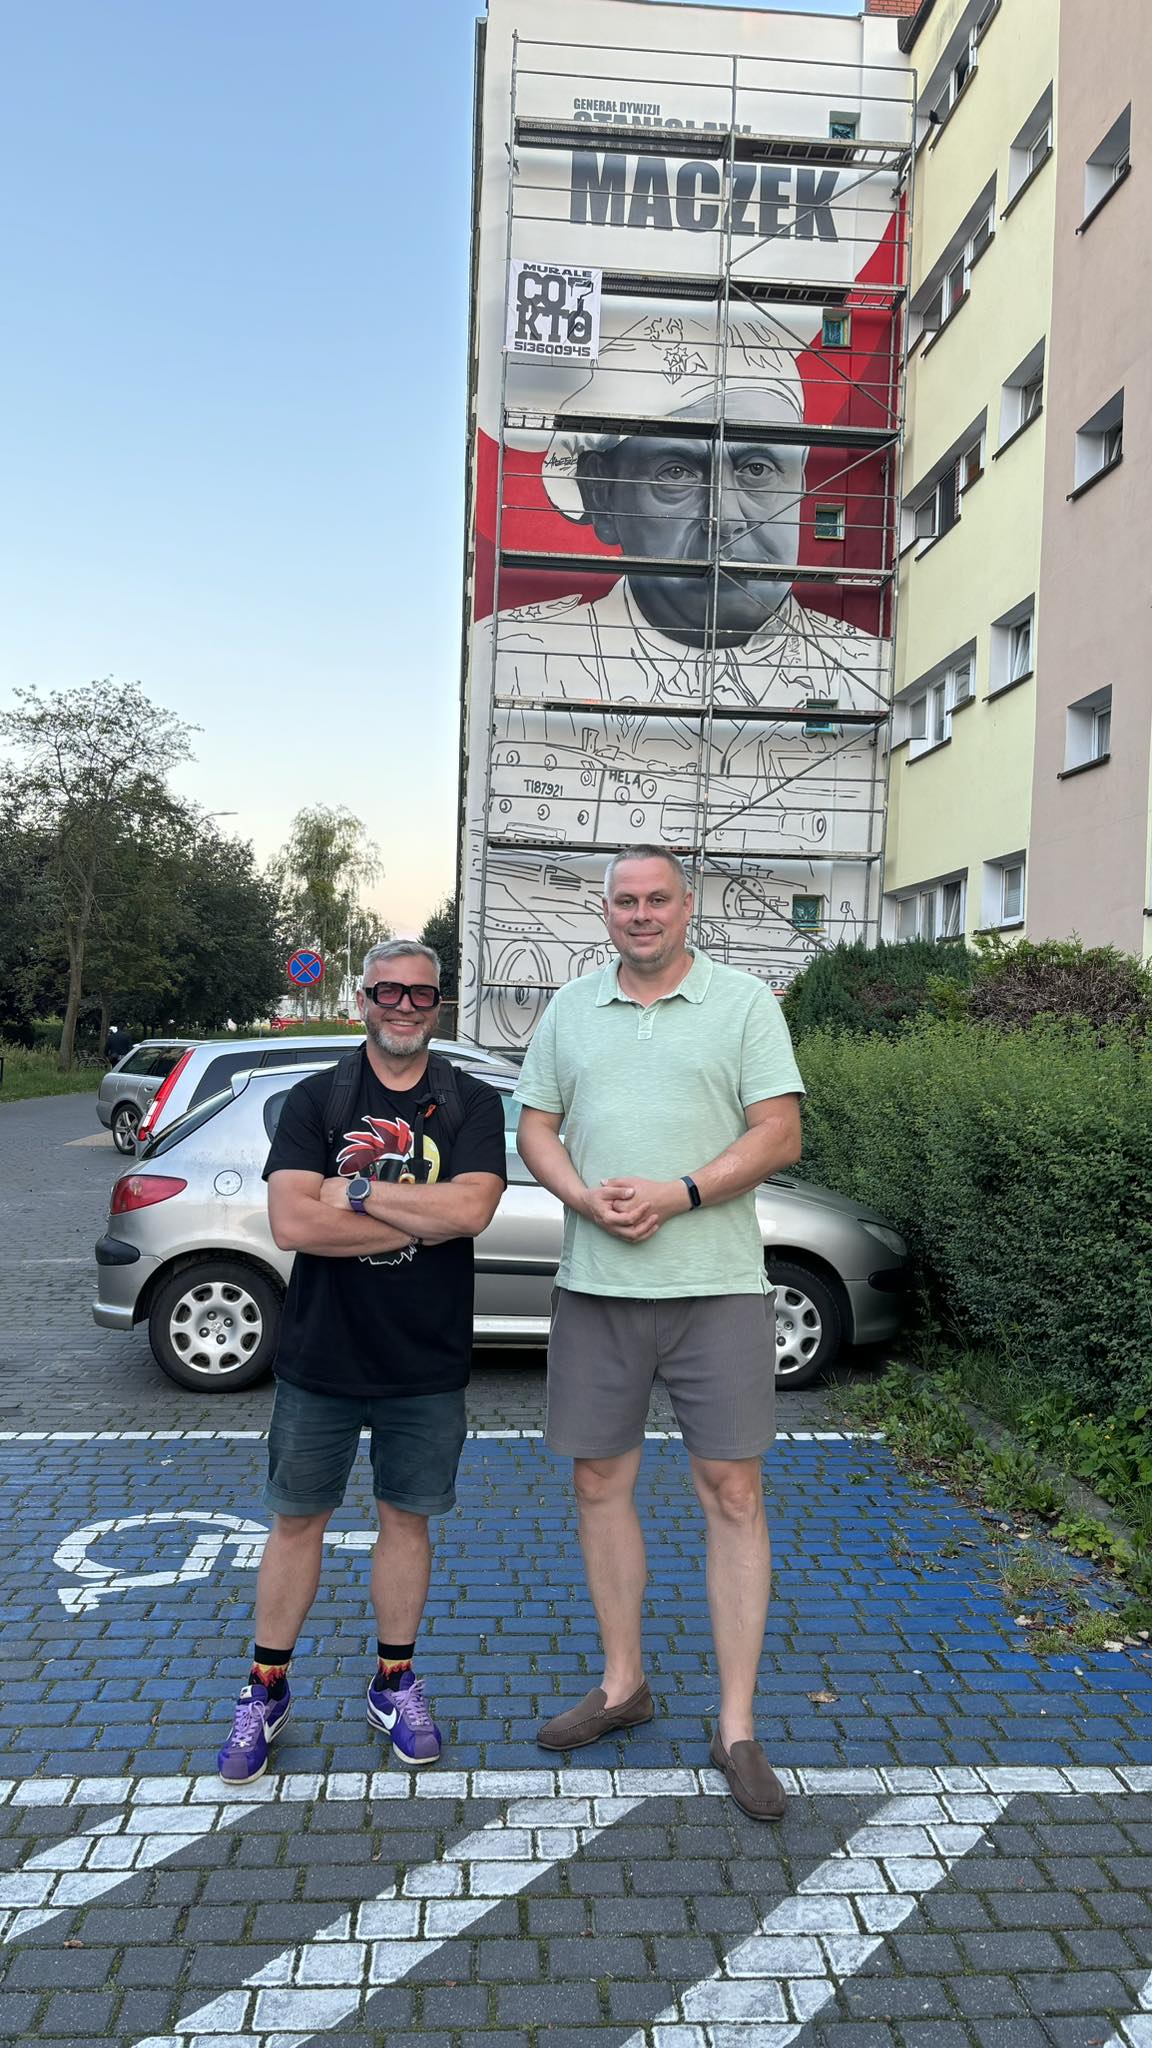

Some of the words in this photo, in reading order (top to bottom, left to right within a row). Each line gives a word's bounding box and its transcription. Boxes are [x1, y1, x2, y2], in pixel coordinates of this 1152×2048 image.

[573, 98, 617, 112] GENERAŁ
[619, 102, 660, 116] DYWIZJI
[569, 152, 839, 243] MACZEK
[523, 263, 592, 278] MURALE
[515, 303, 593, 345] KTO
[514, 341, 591, 357] 513600945
[609, 770, 641, 789] HELA
